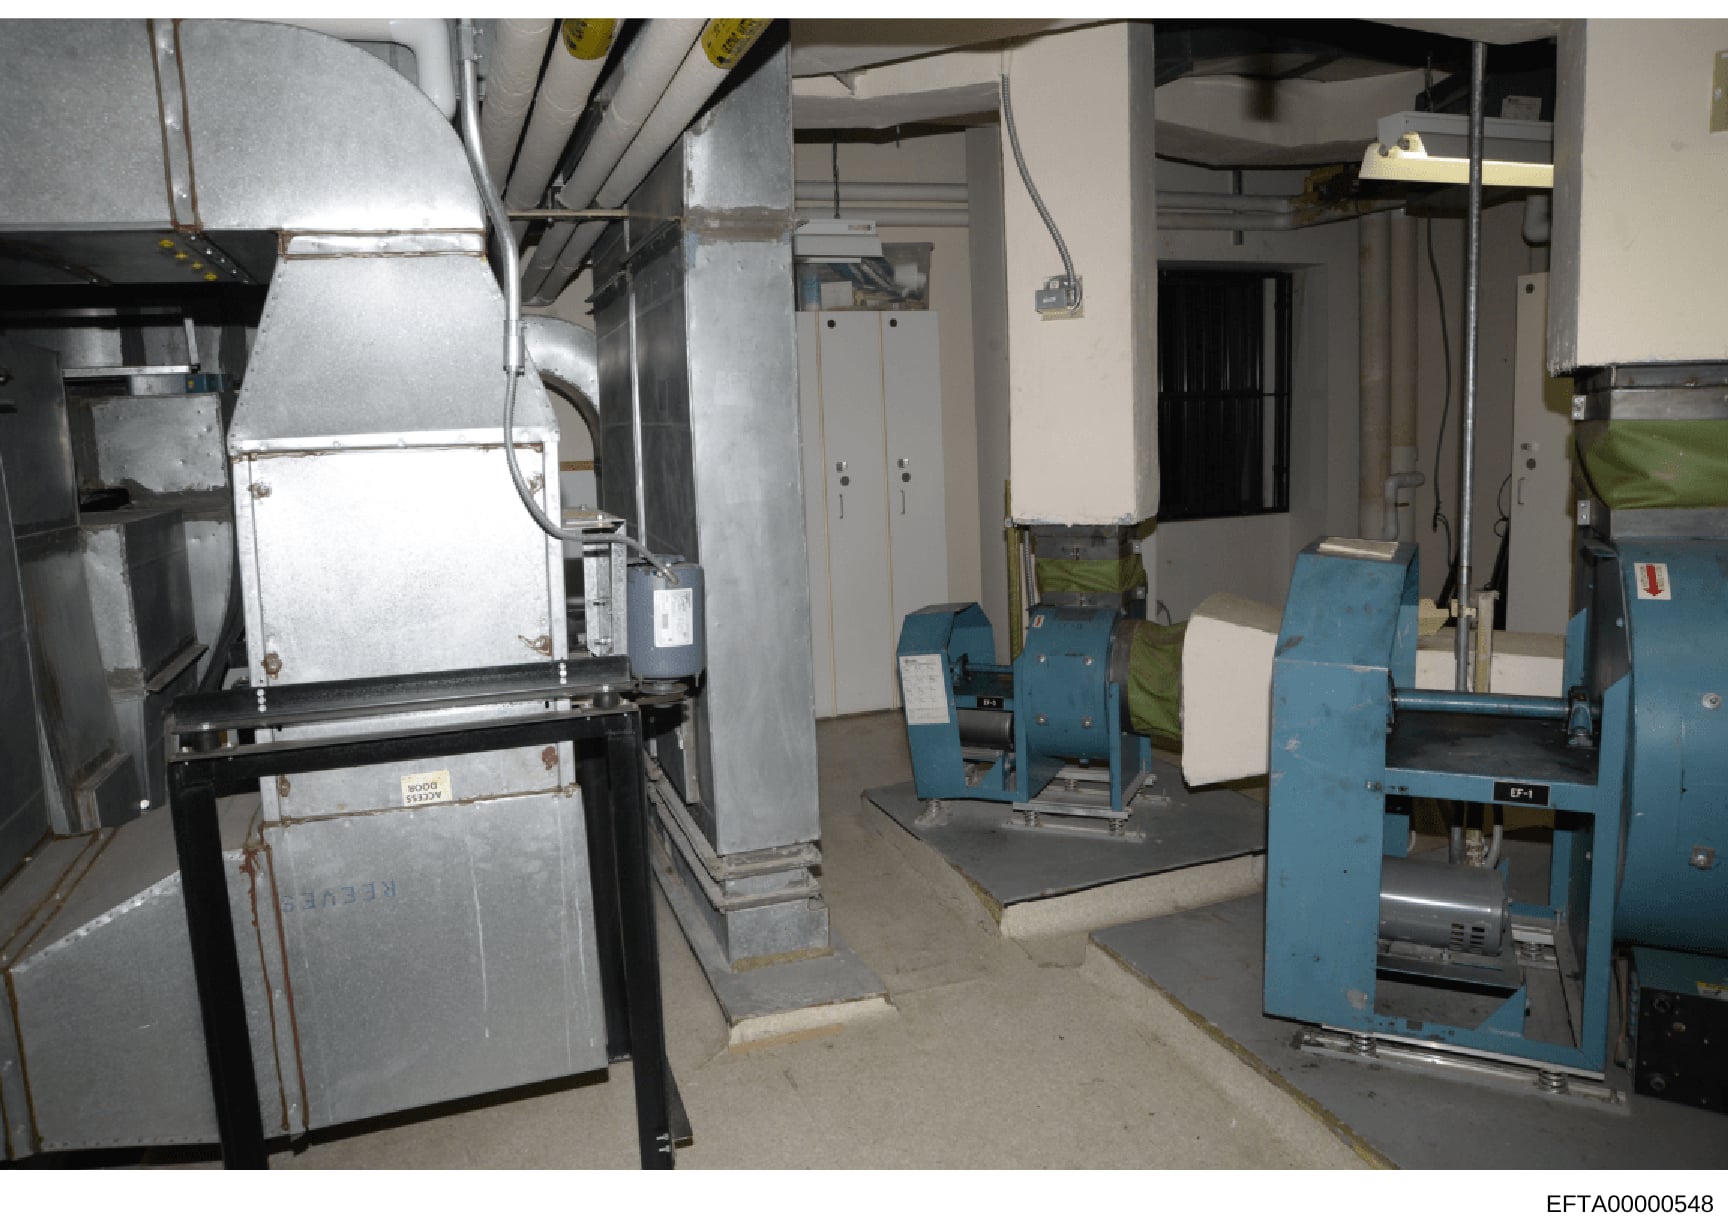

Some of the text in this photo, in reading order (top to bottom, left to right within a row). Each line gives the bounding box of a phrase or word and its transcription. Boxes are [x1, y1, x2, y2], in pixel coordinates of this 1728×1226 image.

[407, 782, 438, 792] DOOR
[1510, 787, 1532, 799] EF-1
[406, 791, 441, 803] ACCESS
[280, 879, 396, 913] REEVES
